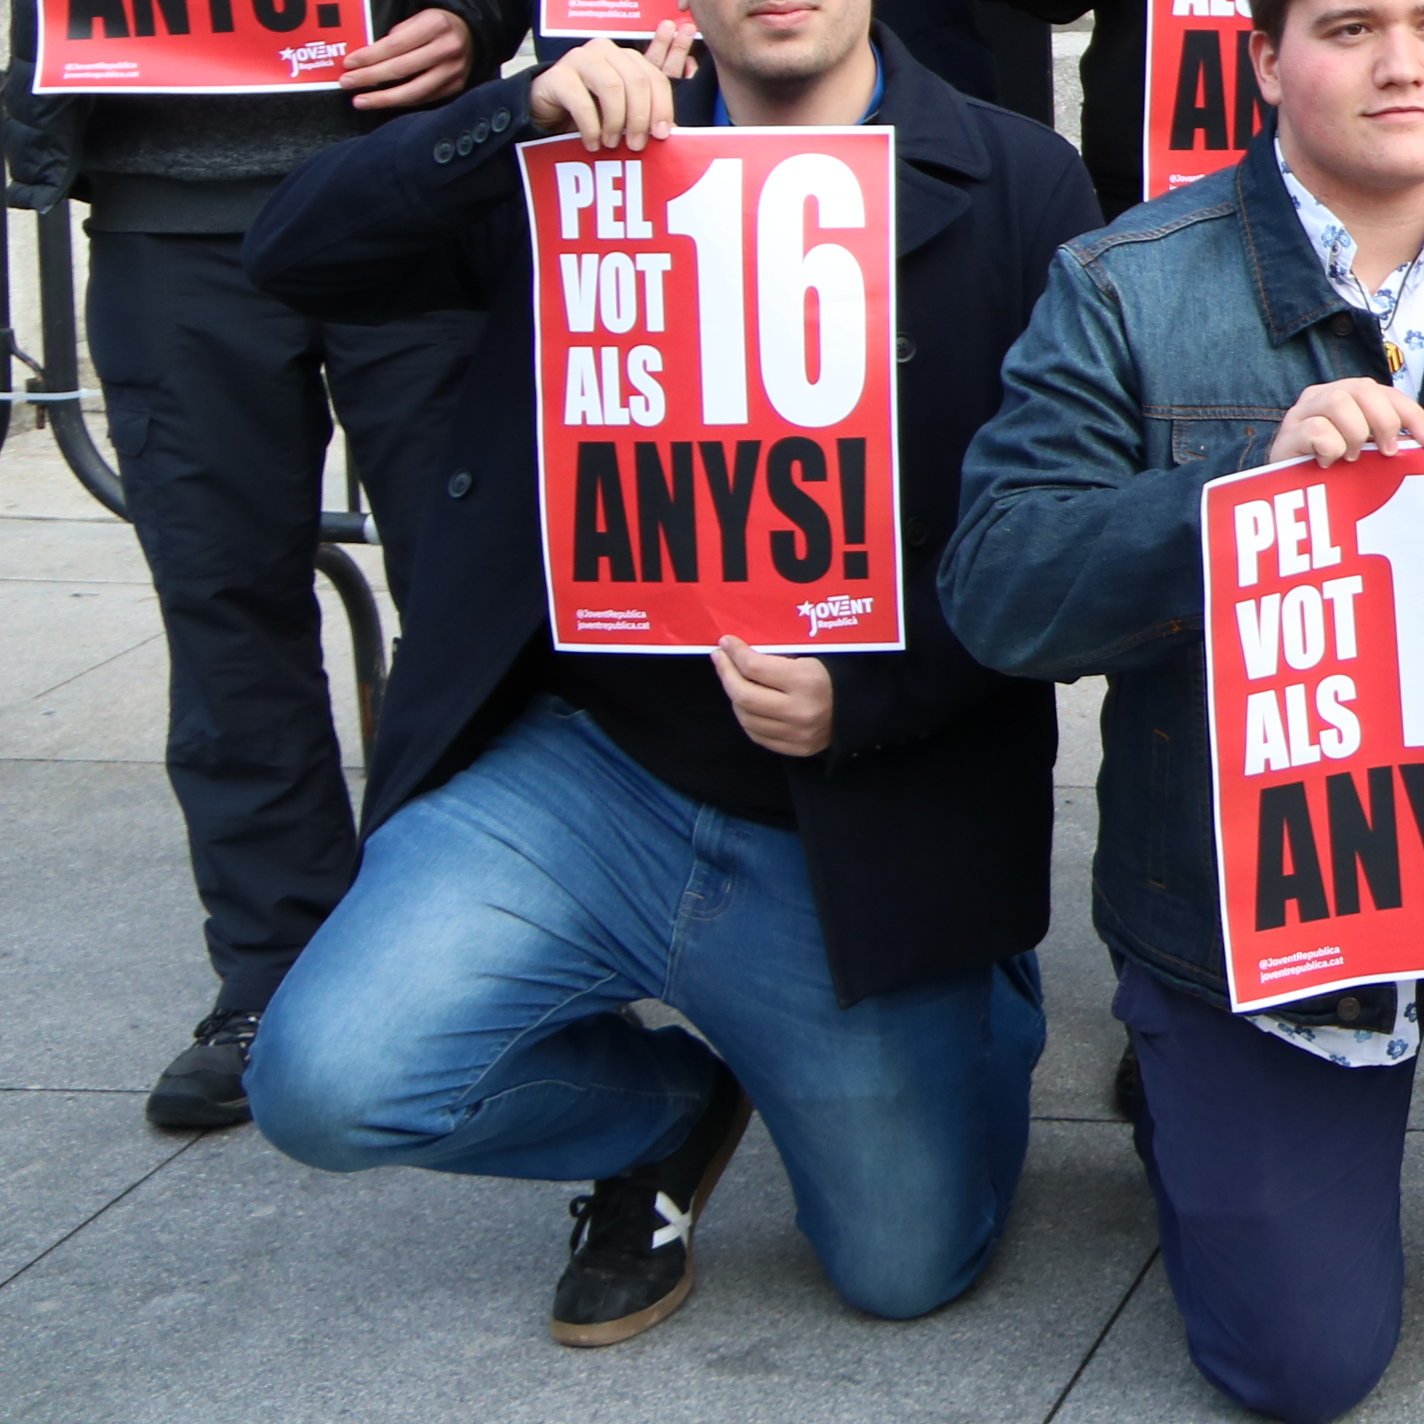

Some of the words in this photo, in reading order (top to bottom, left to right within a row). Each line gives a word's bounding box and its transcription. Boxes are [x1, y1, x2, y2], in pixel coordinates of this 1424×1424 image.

[290, 42, 347, 77] JOVENT
[555, 159, 652, 239] PEL
[559, 251, 671, 334] VOT
[666, 152, 867, 428] 16
[563, 344, 666, 427] ALS
[572, 436, 870, 583] ANYS!
[1233, 483, 1342, 588] PEL
[809, 595, 874, 637] JOVENT
[1235, 575, 1363, 681] VOT
[1243, 674, 1361, 776] ALS
[1259, 946, 1340, 969] @JoventRepublica
[1260, 956, 1344, 984] joventrepublica.cat
